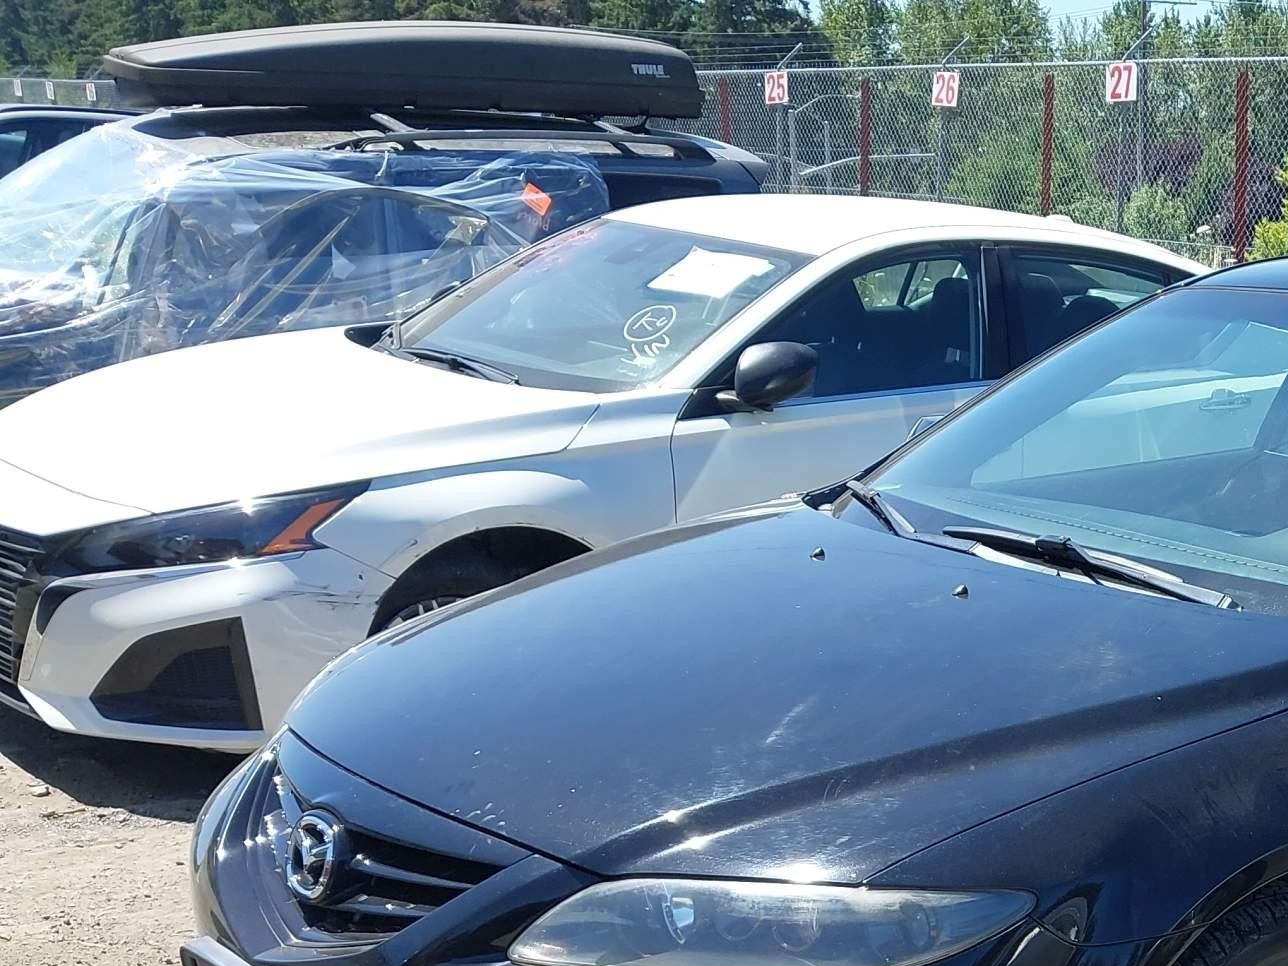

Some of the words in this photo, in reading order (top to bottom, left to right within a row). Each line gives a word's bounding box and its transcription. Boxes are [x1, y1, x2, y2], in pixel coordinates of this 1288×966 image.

[767, 73, 785, 102] 25
[934, 74, 956, 104] 26
[1110, 65, 1133, 99] 27
